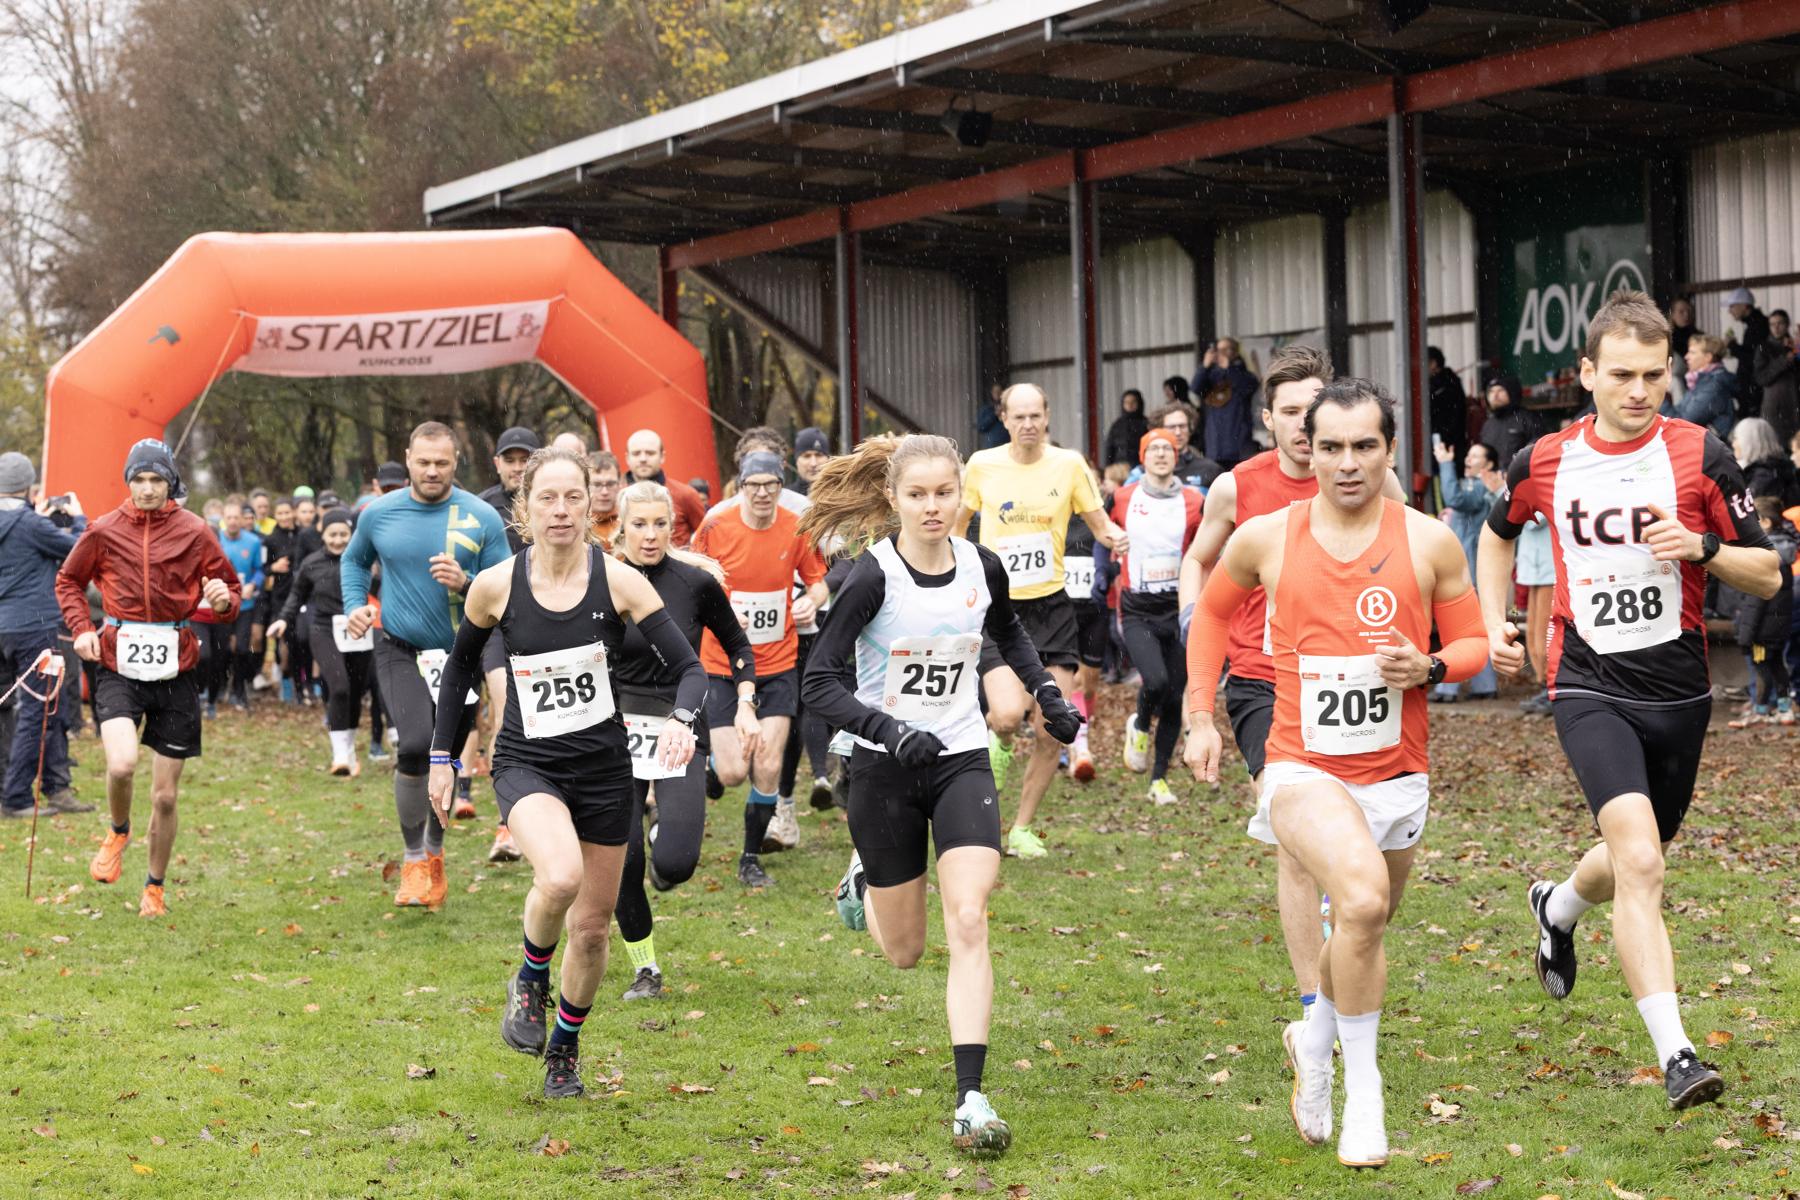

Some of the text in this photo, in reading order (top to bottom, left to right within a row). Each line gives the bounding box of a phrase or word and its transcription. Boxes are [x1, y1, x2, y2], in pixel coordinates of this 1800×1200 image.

[285, 311, 512, 352] START/ZIEL
[1513, 281, 1596, 355] AOK
[358, 356, 433, 367] KUHCROSS
[1007, 513, 1036, 523] WORLD
[1008, 550, 1046, 572] 278
[1064, 571, 1091, 585] 214
[1591, 586, 1663, 627] 288
[127, 643, 169, 665] 233
[532, 672, 597, 713] 258
[900, 661, 965, 697] 257
[1317, 686, 1389, 726] 205
[629, 732, 671, 759] 27
